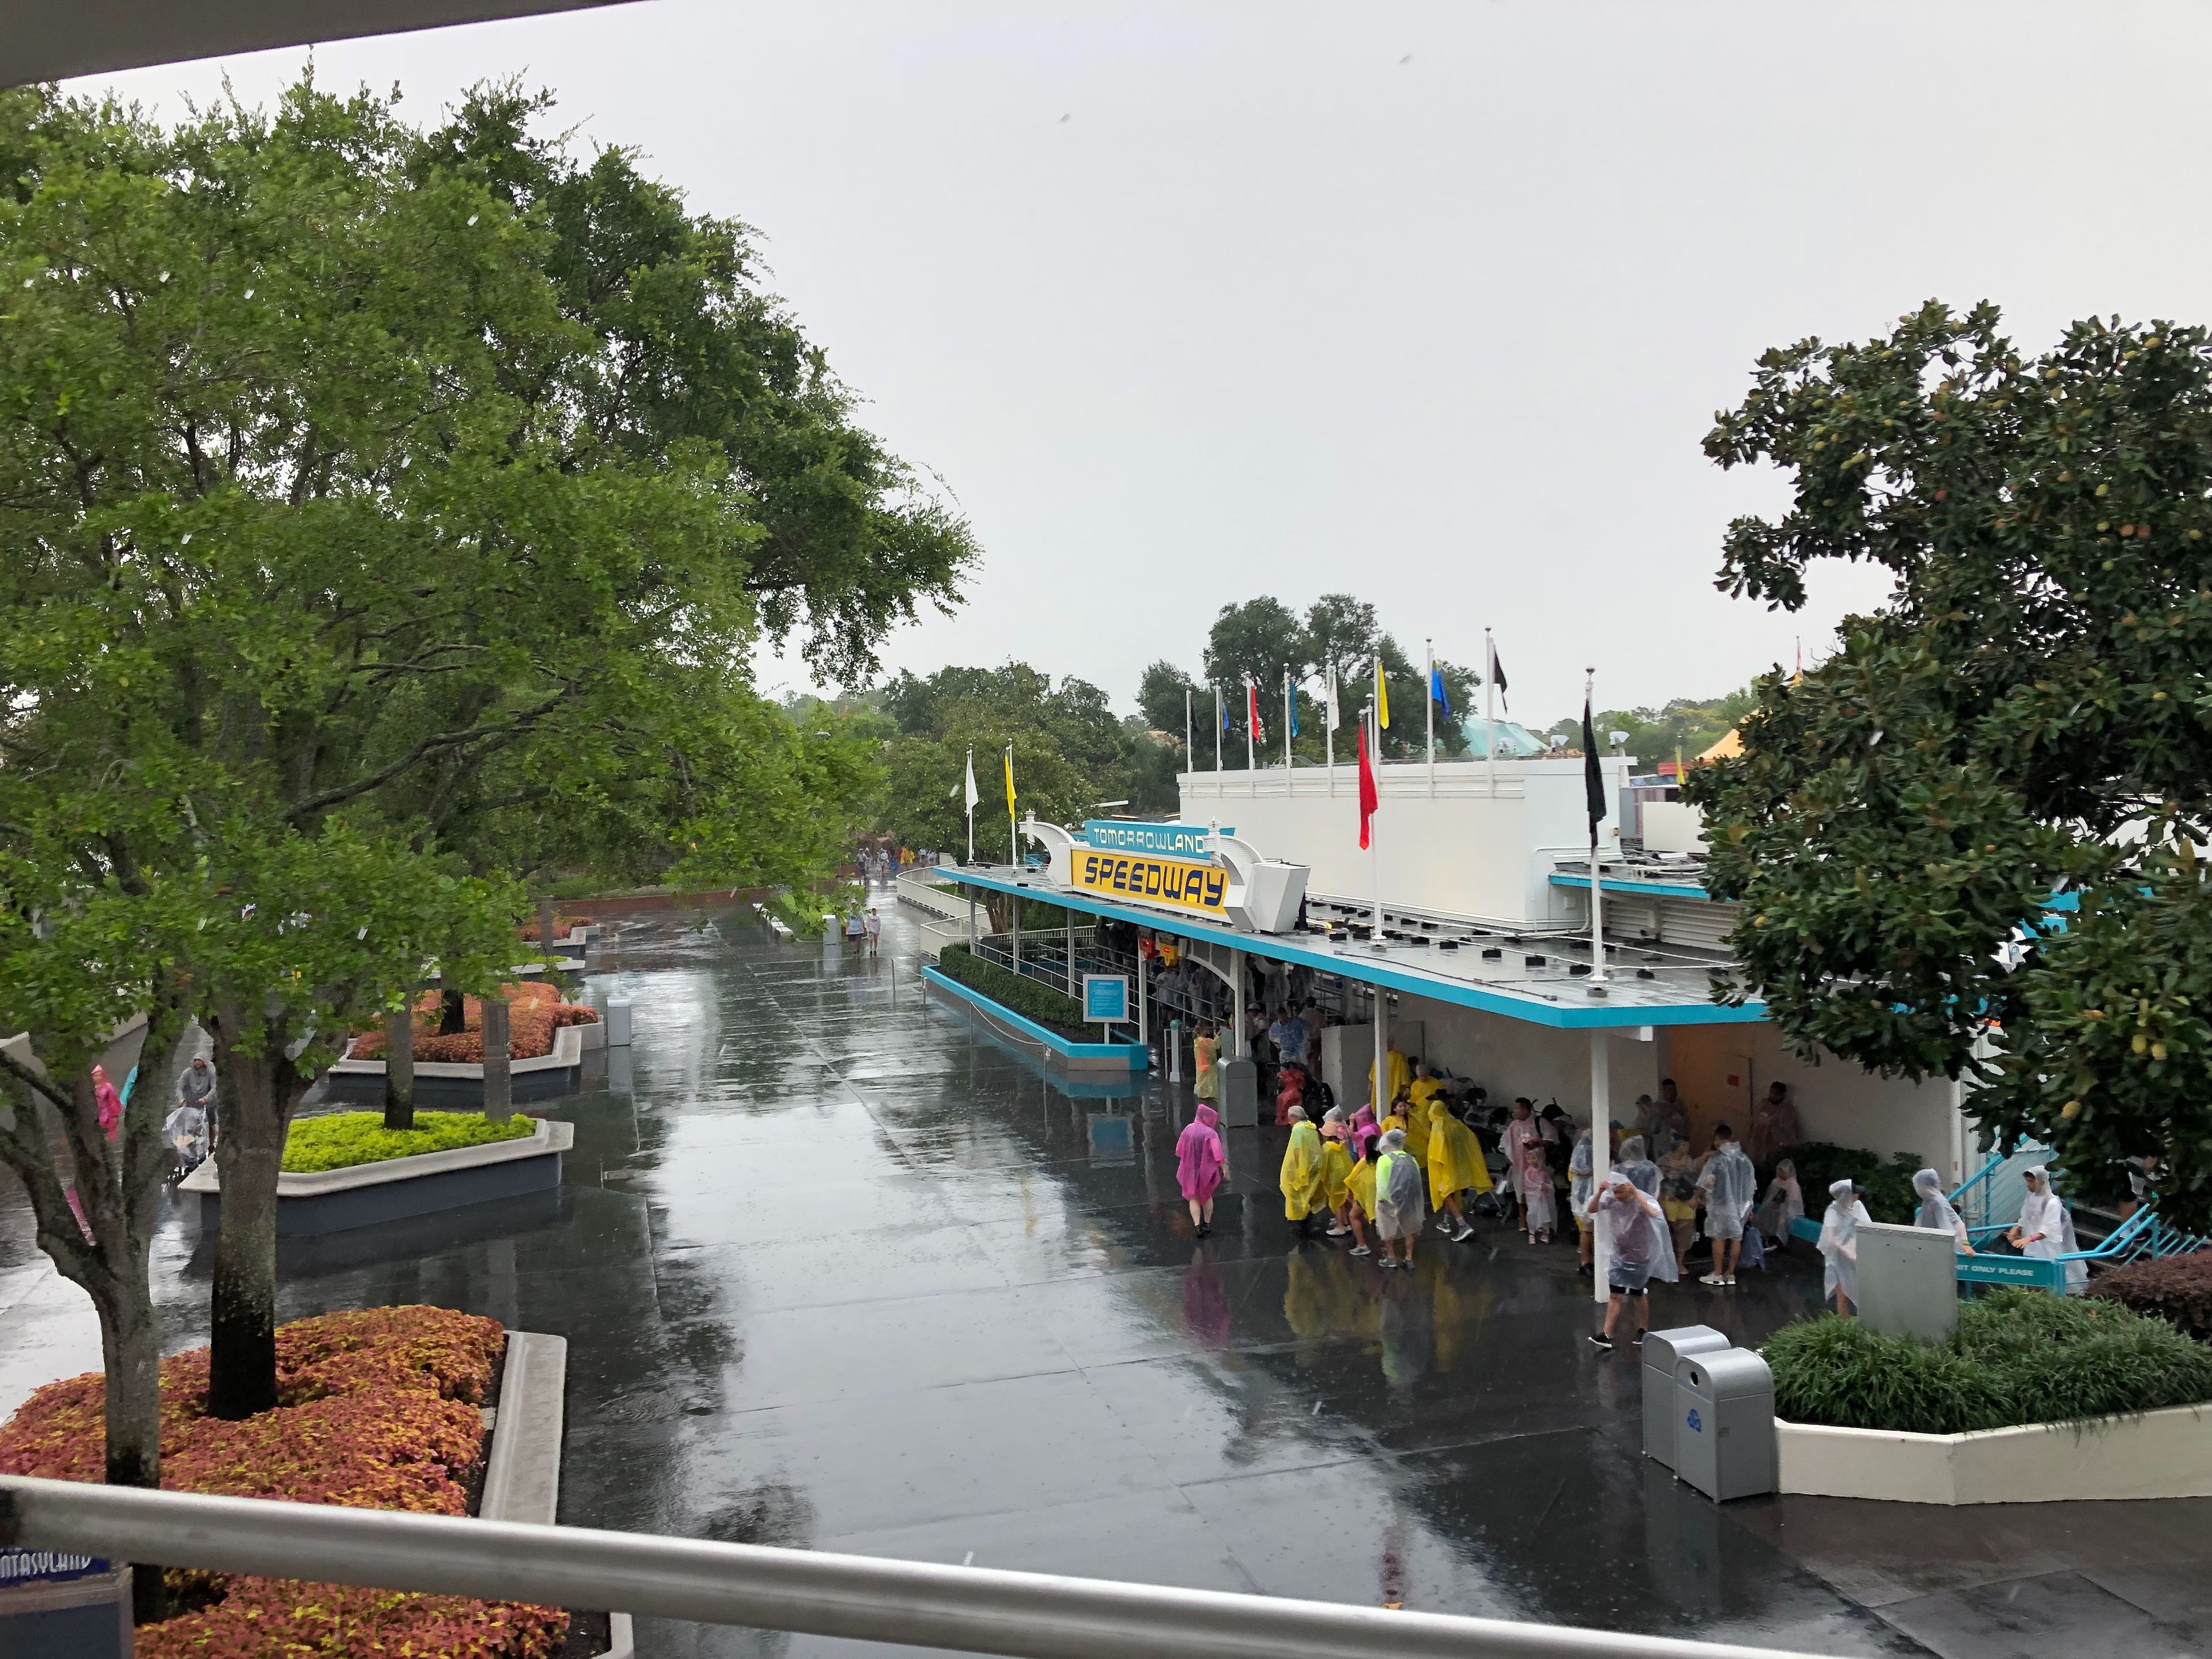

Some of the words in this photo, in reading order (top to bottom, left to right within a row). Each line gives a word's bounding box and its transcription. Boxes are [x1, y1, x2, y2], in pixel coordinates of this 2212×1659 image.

[1093, 828, 1204, 854] TOMORROWLAND
[1085, 856, 1224, 907] SPEEDWAY
[1998, 1267, 2034, 1277] PLEASE
[0, 1551, 92, 1579] NTASYLAND
